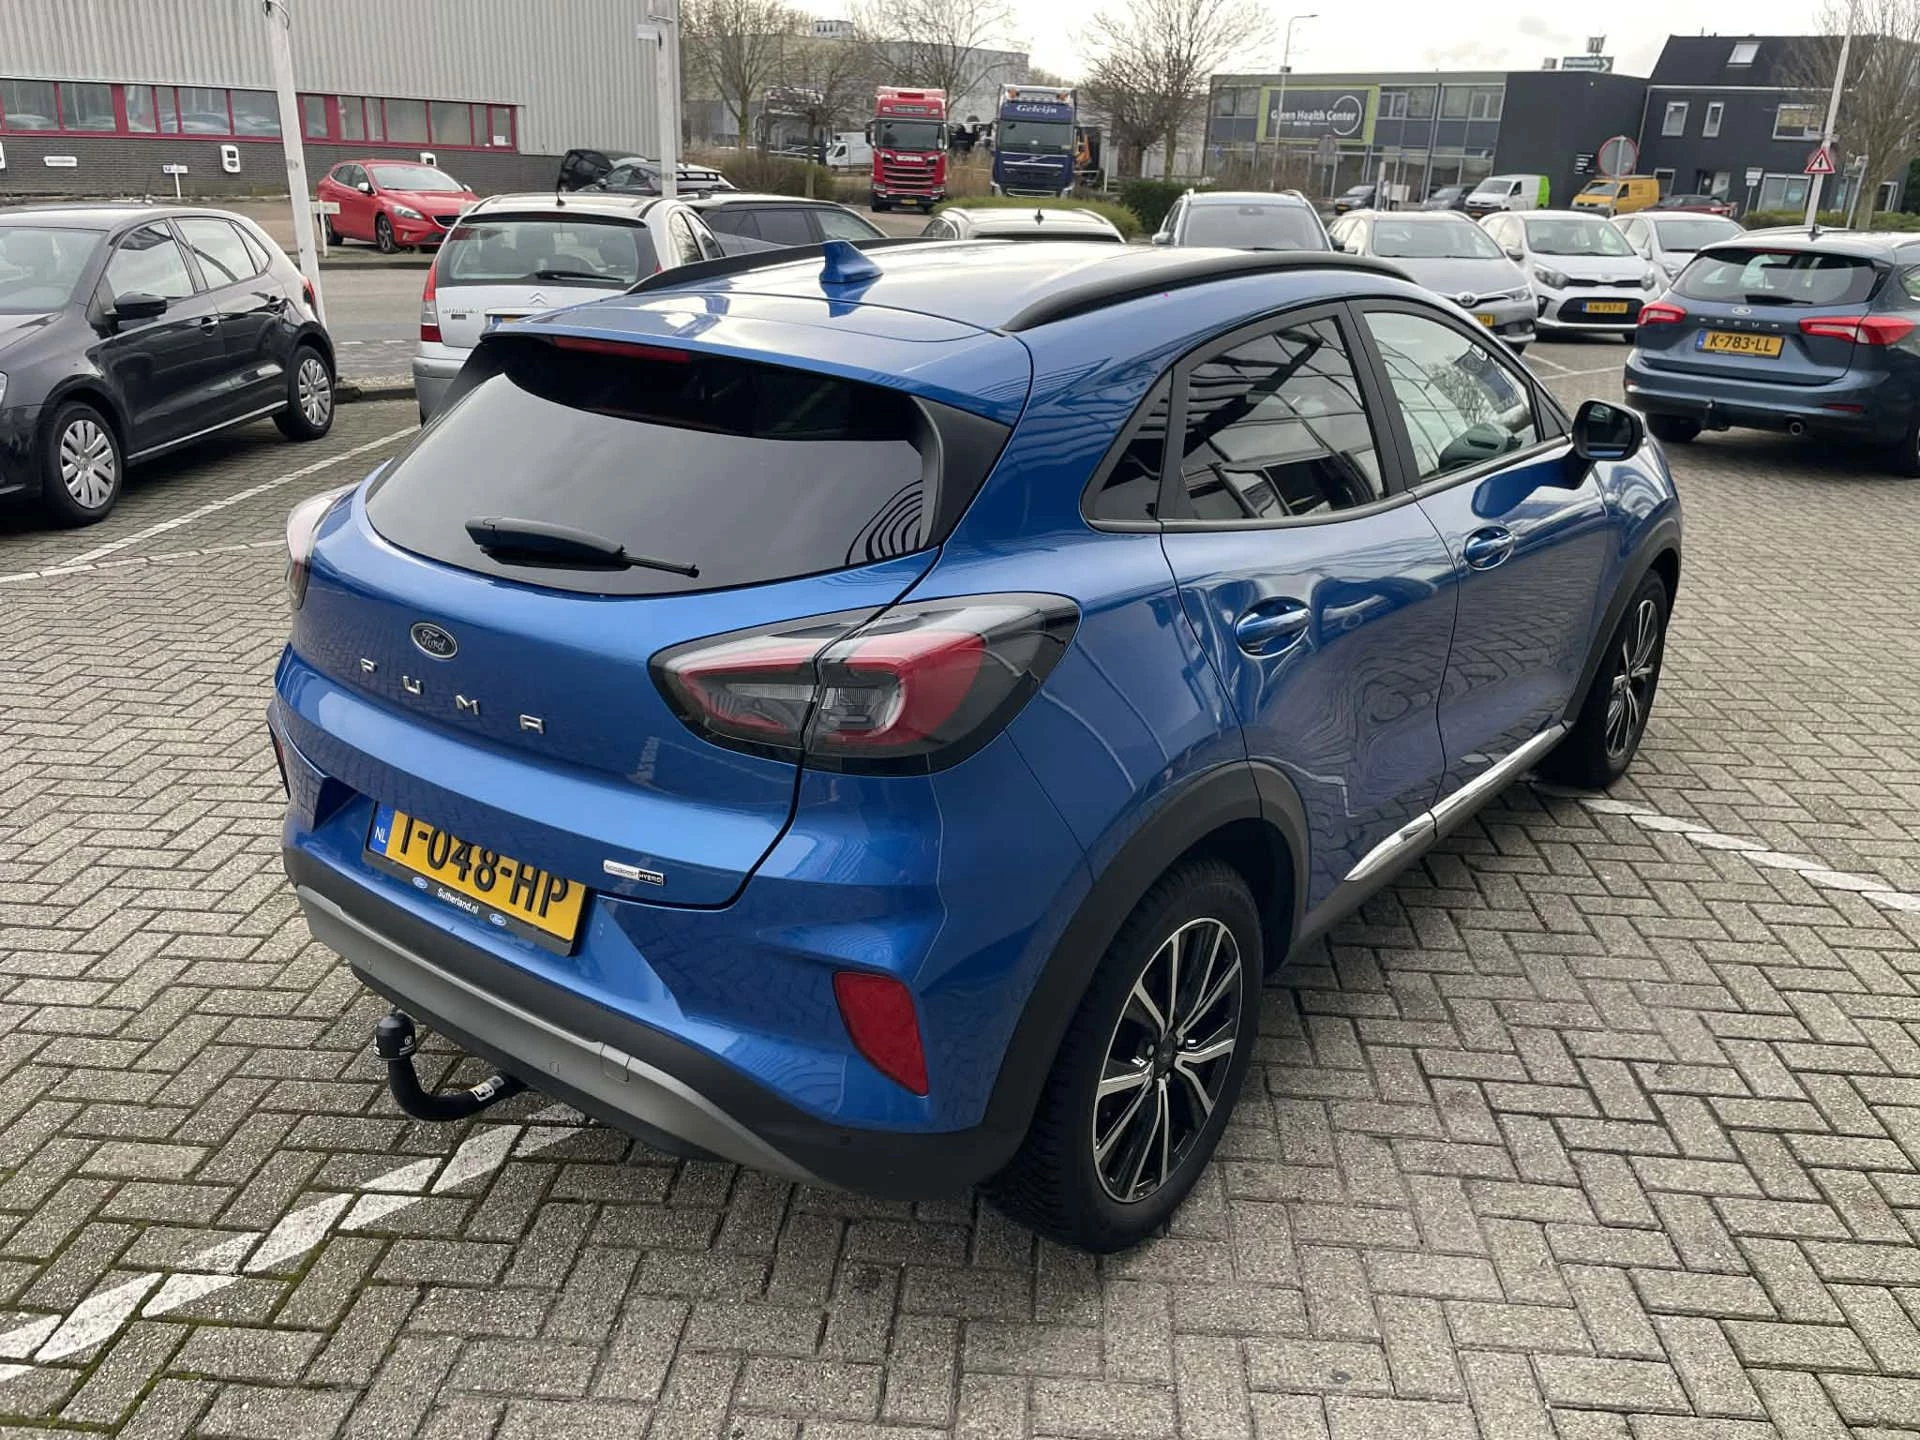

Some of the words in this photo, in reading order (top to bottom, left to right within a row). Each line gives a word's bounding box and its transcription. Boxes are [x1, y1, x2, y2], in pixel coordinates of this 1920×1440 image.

[1297, 110, 1324, 120] Health
[1327, 110, 1356, 121] Center
[1709, 333, 1772, 352] K-783-LL
[420, 628, 446, 652] Ford
[360, 657, 545, 735] PUMA
[374, 826, 386, 844] NL
[437, 887, 479, 914] Sutherland.nl
